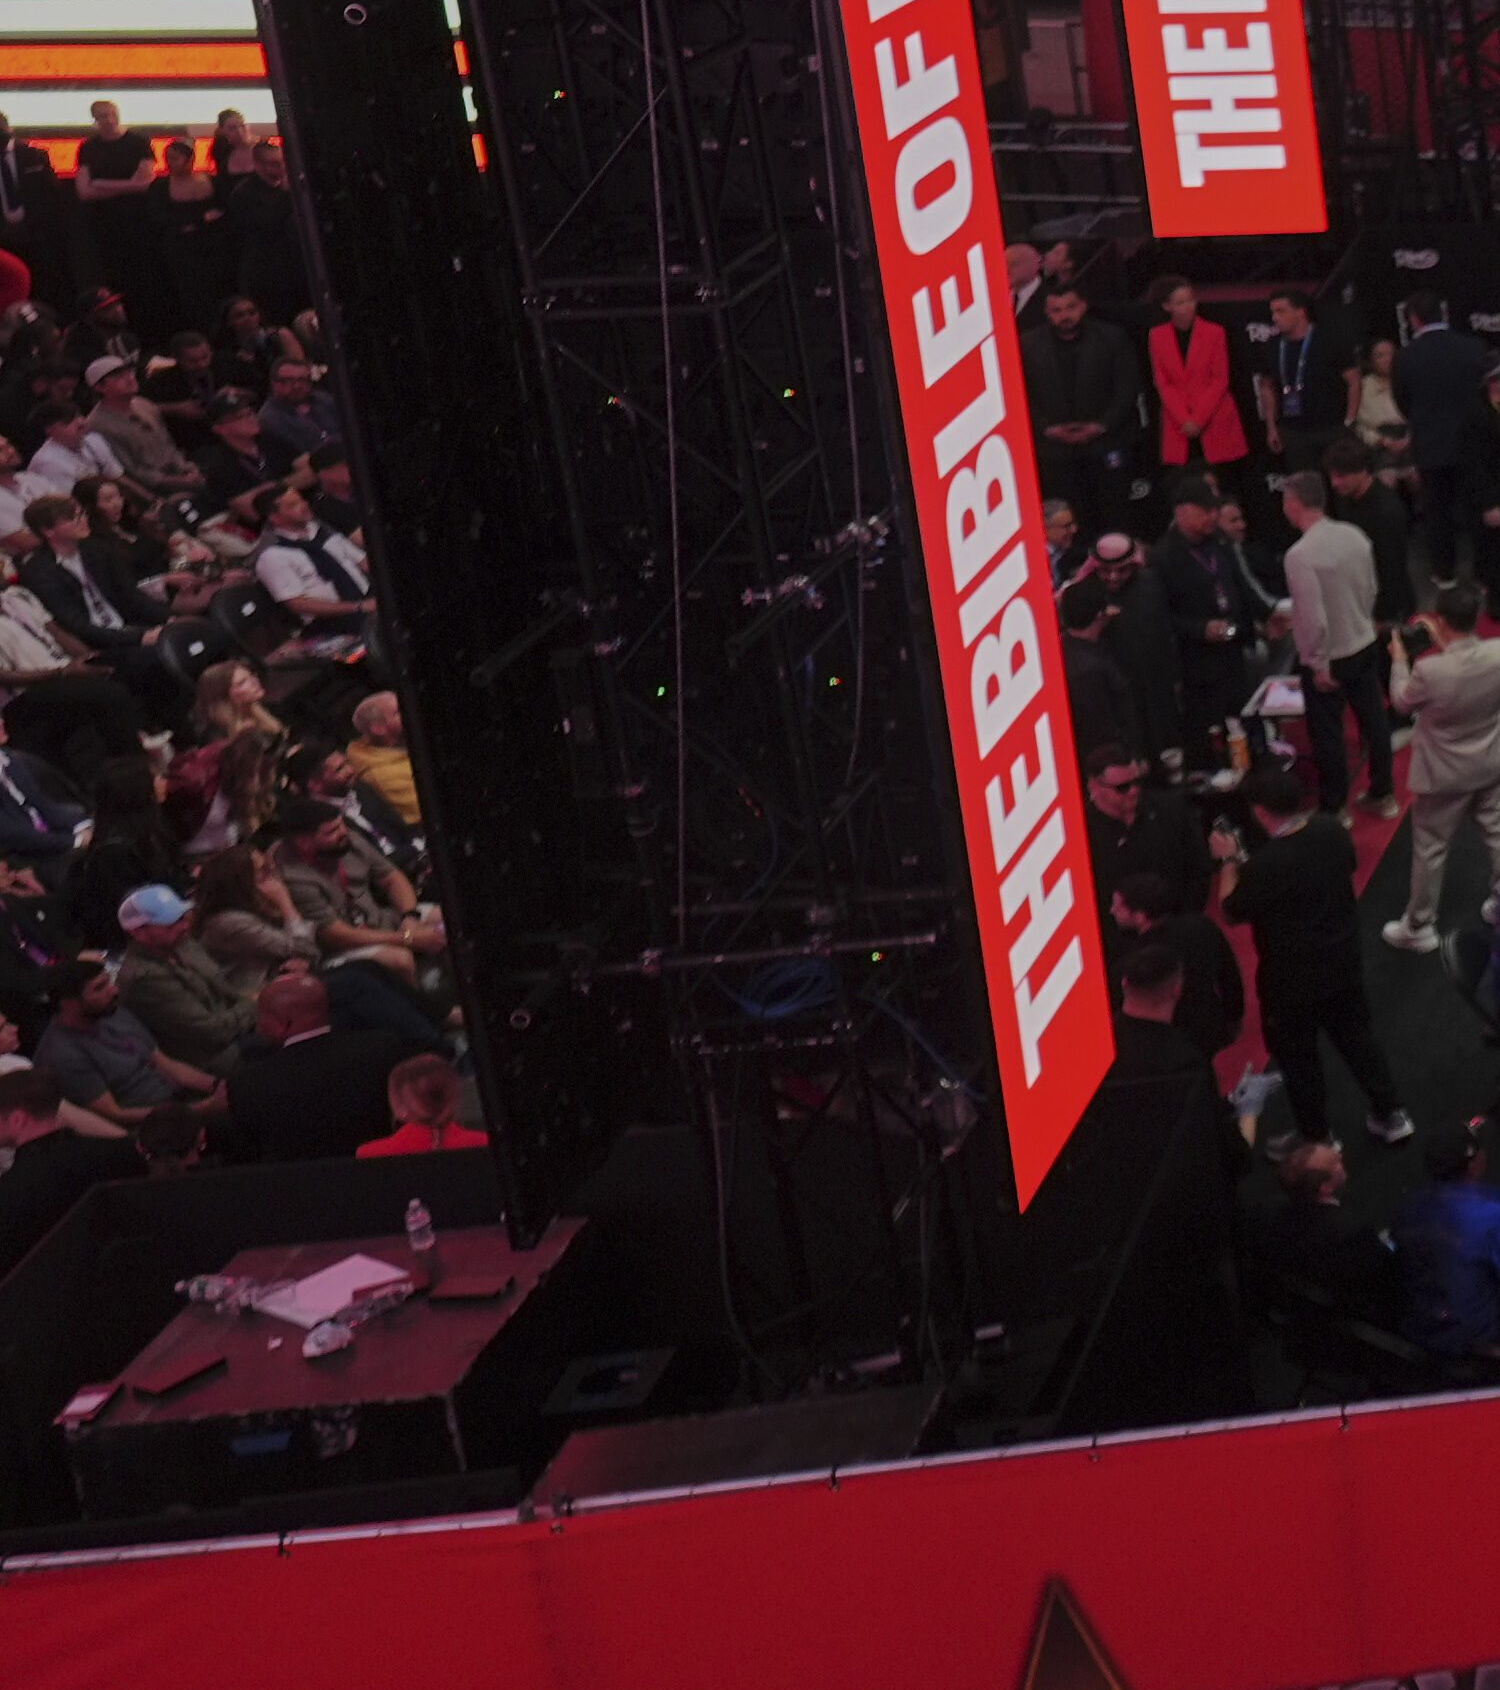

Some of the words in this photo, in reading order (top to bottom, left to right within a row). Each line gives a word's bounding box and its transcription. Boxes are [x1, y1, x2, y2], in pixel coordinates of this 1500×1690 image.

[875, 32, 972, 254] OF
[1162, 23, 1286, 187] THE
[913, 244, 1043, 759] BIBLE
[986, 714, 1082, 1087] THE
